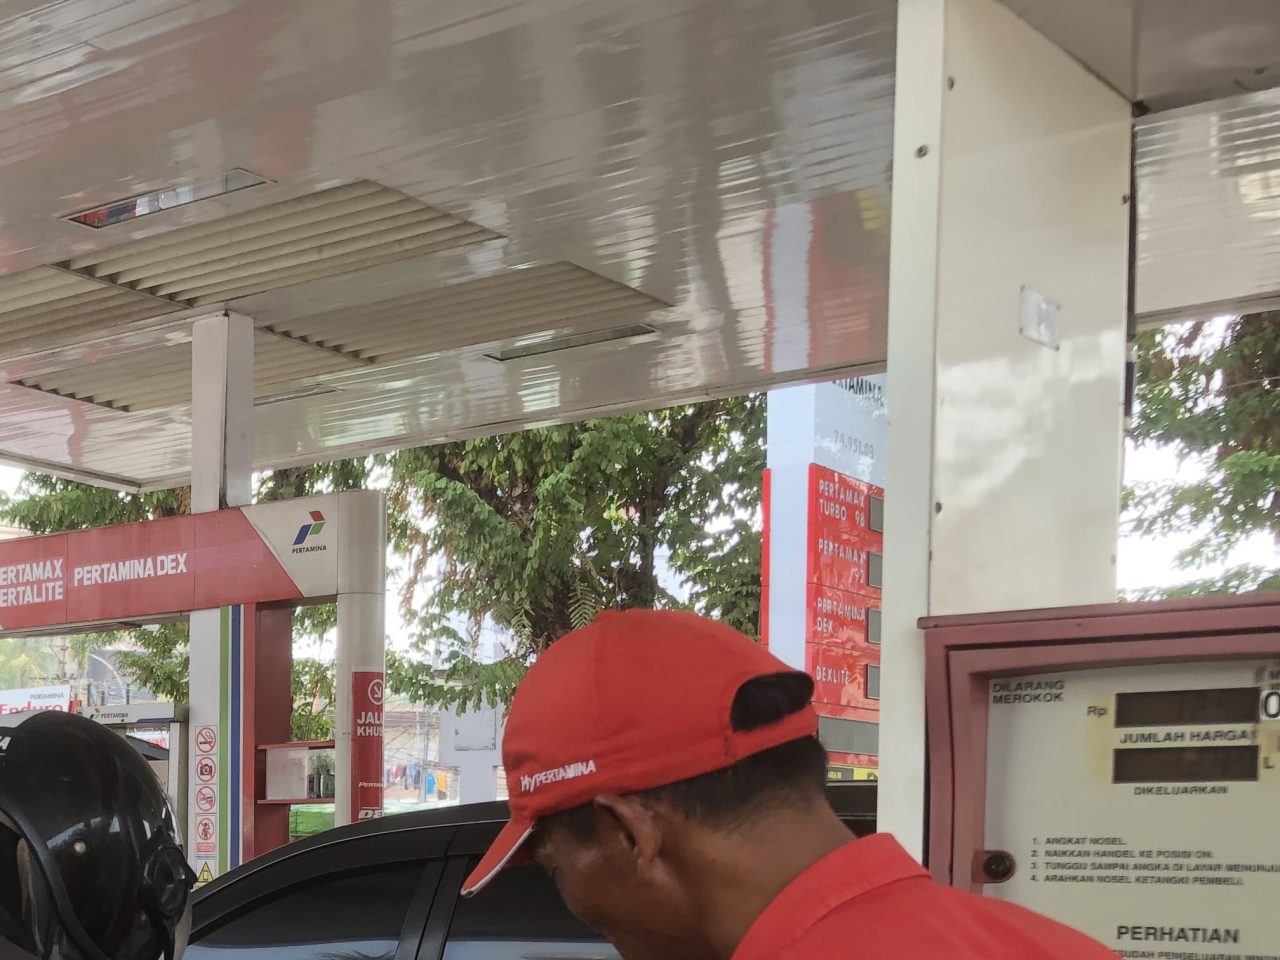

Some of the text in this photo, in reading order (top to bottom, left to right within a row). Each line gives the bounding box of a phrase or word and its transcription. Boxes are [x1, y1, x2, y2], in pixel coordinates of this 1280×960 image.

[819, 480, 865, 508] PERTAMAX
[819, 499, 865, 527] TURBO 98
[292, 545, 327, 554] PERTAMINA
[818, 538, 866, 565] PERTAMAX
[73, 552, 188, 587] PERTAMINA DEX
[817, 597, 866, 621] PERTAMINA
[817, 617, 834, 634] DEX
[816, 665, 850, 685] DEXLITE
[992, 680, 1065, 693] DILARANG
[992, 692, 1065, 705] MEROKOK
[1087, 705, 1109, 718] Rp
[1120, 730, 1249, 745] JUMLAH HARGA
[1133, 785, 1229, 796] DIKELUARKAN
[1045, 837, 1087, 845] ANGKAT
[1044, 850, 1091, 858] NAIKKAN
[1138, 850, 1153, 858] KE
[1044, 862, 1087, 870] TUNGGU
[1090, 862, 1129, 870] SAMPAI
[1131, 863, 1170, 872] ANGKA
[1044, 874, 1094, 883] ARAHKAN
[1096, 875, 1133, 884] NOSEL
[1116, 925, 1240, 944] PERHATIAN
